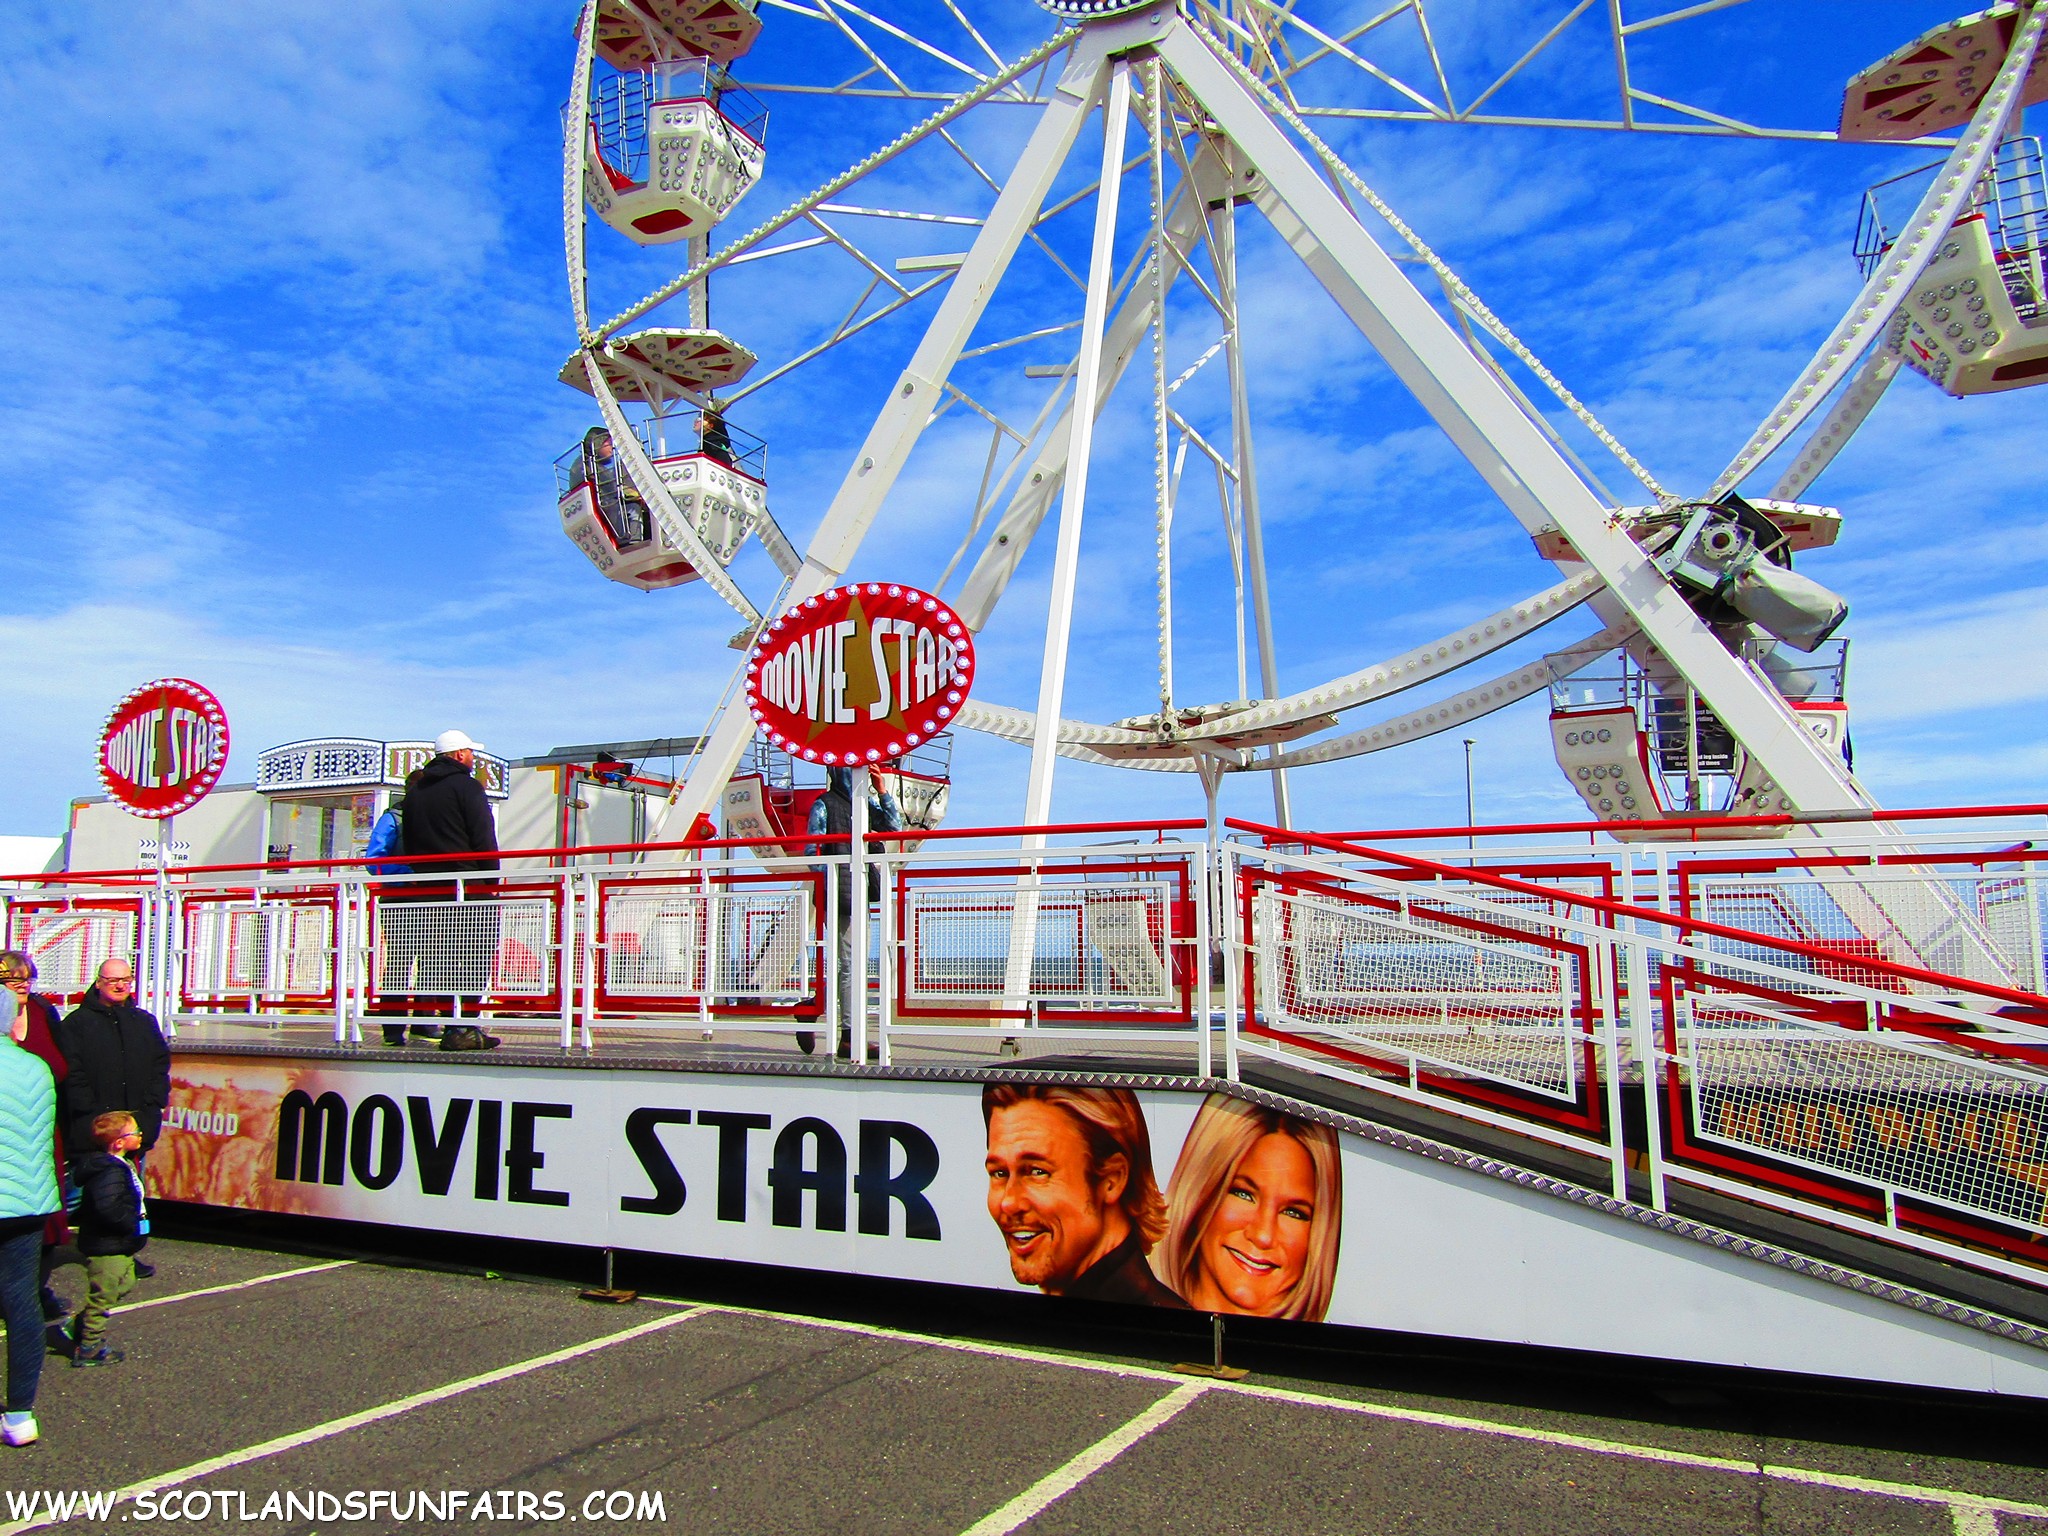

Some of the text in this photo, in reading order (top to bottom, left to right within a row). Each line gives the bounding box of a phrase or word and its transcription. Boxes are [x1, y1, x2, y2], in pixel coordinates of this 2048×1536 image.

[762, 617, 958, 724] MOVIE STAR
[107, 708, 164, 789] MOVIE
[265, 749, 376, 783] PAY HERE
[276, 1089, 942, 1241] MOVIE STAR
